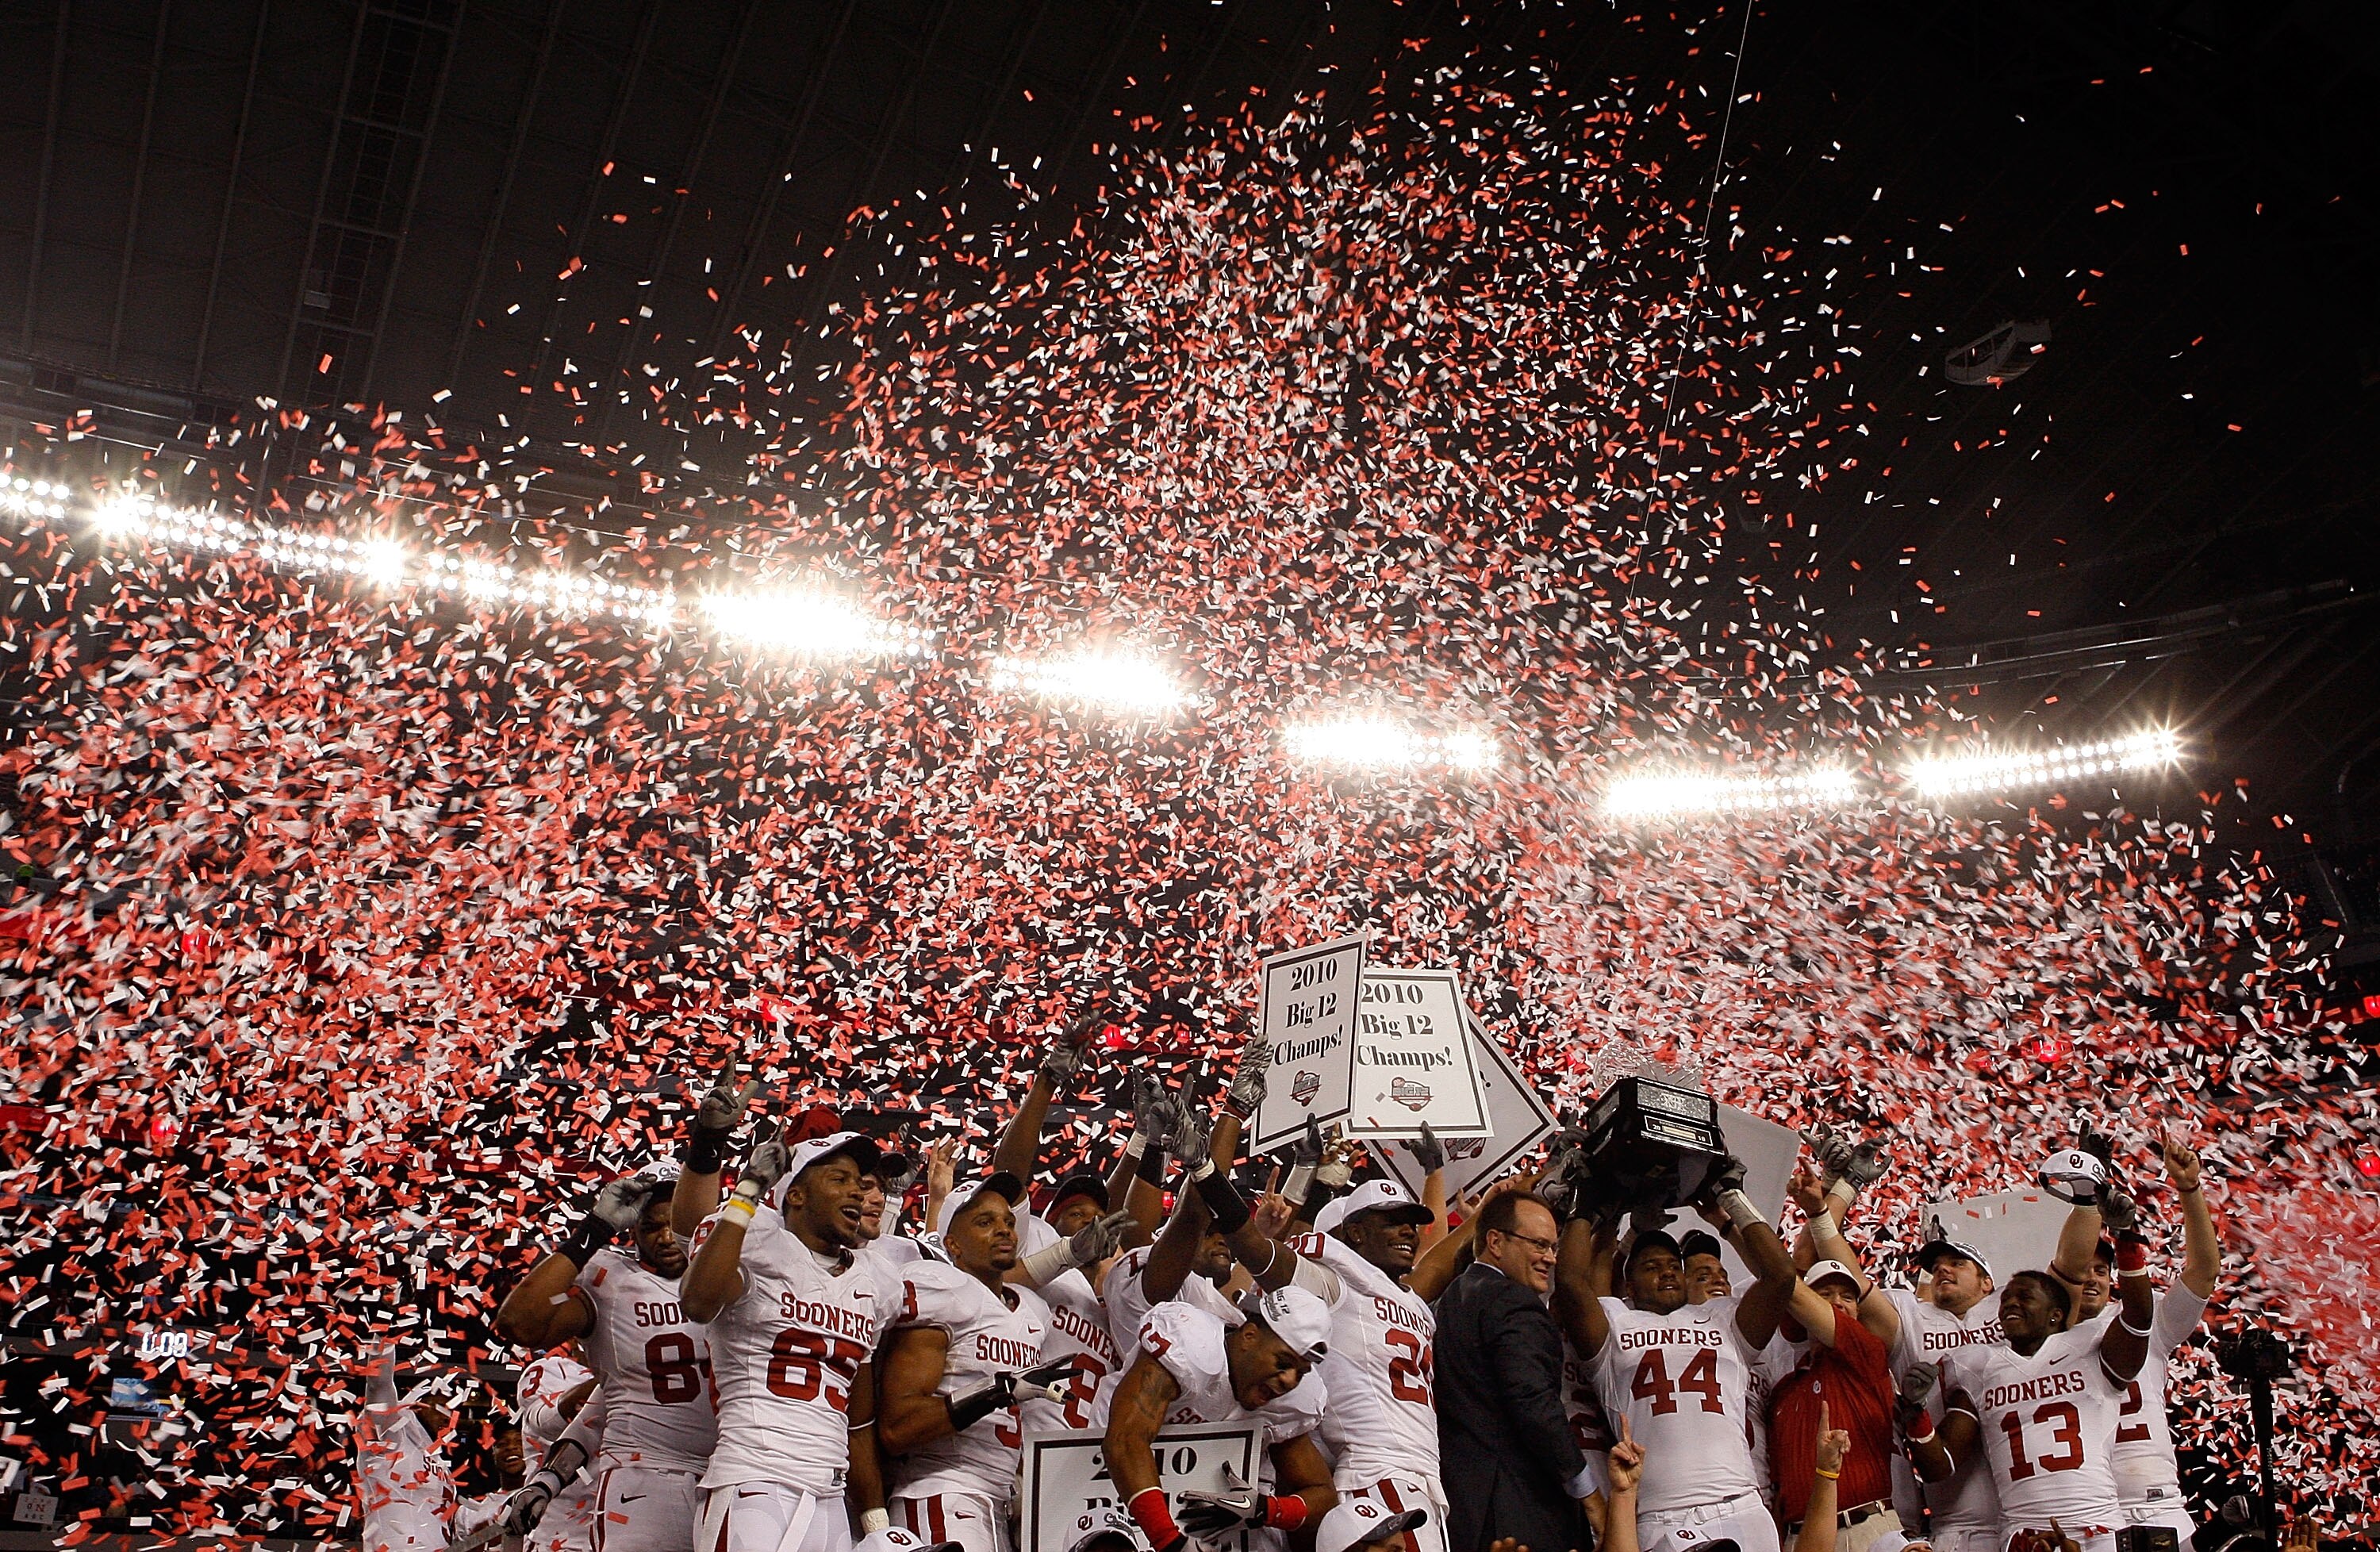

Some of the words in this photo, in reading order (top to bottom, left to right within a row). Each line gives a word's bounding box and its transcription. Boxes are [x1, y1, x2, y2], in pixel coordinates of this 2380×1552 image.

[1290, 958, 1338, 992] 2010
[1361, 982, 1423, 1005] 2010
[1285, 1001, 1315, 1028] Big
[1317, 993, 1337, 1019] 12
[1361, 1013, 1403, 1040] Big
[1404, 1014, 1434, 1035] 12
[1274, 1024, 1343, 1066] Champs!
[1357, 1044, 1453, 1072] Champs!
[2069, 1154, 2084, 1169] OU
[1380, 1182, 1398, 1196] OU
[634, 1301, 689, 1327] SOO
[781, 1291, 874, 1346] SOONERS
[1620, 1328, 1723, 1350] SOONERS
[1923, 1322, 2006, 1351] SOONERS
[522, 1365, 544, 1400] 3
[766, 1327, 866, 1413] 85
[1630, 1347, 1726, 1417] 44
[1984, 1370, 2086, 1412] SOONERS
[2000, 1400, 2085, 1482] 13
[1077, 1515, 1093, 1531] OU
[1354, 1504, 1379, 1519] OU
[886, 1531, 912, 1546] OU
[1676, 1529, 1696, 1540] OU
